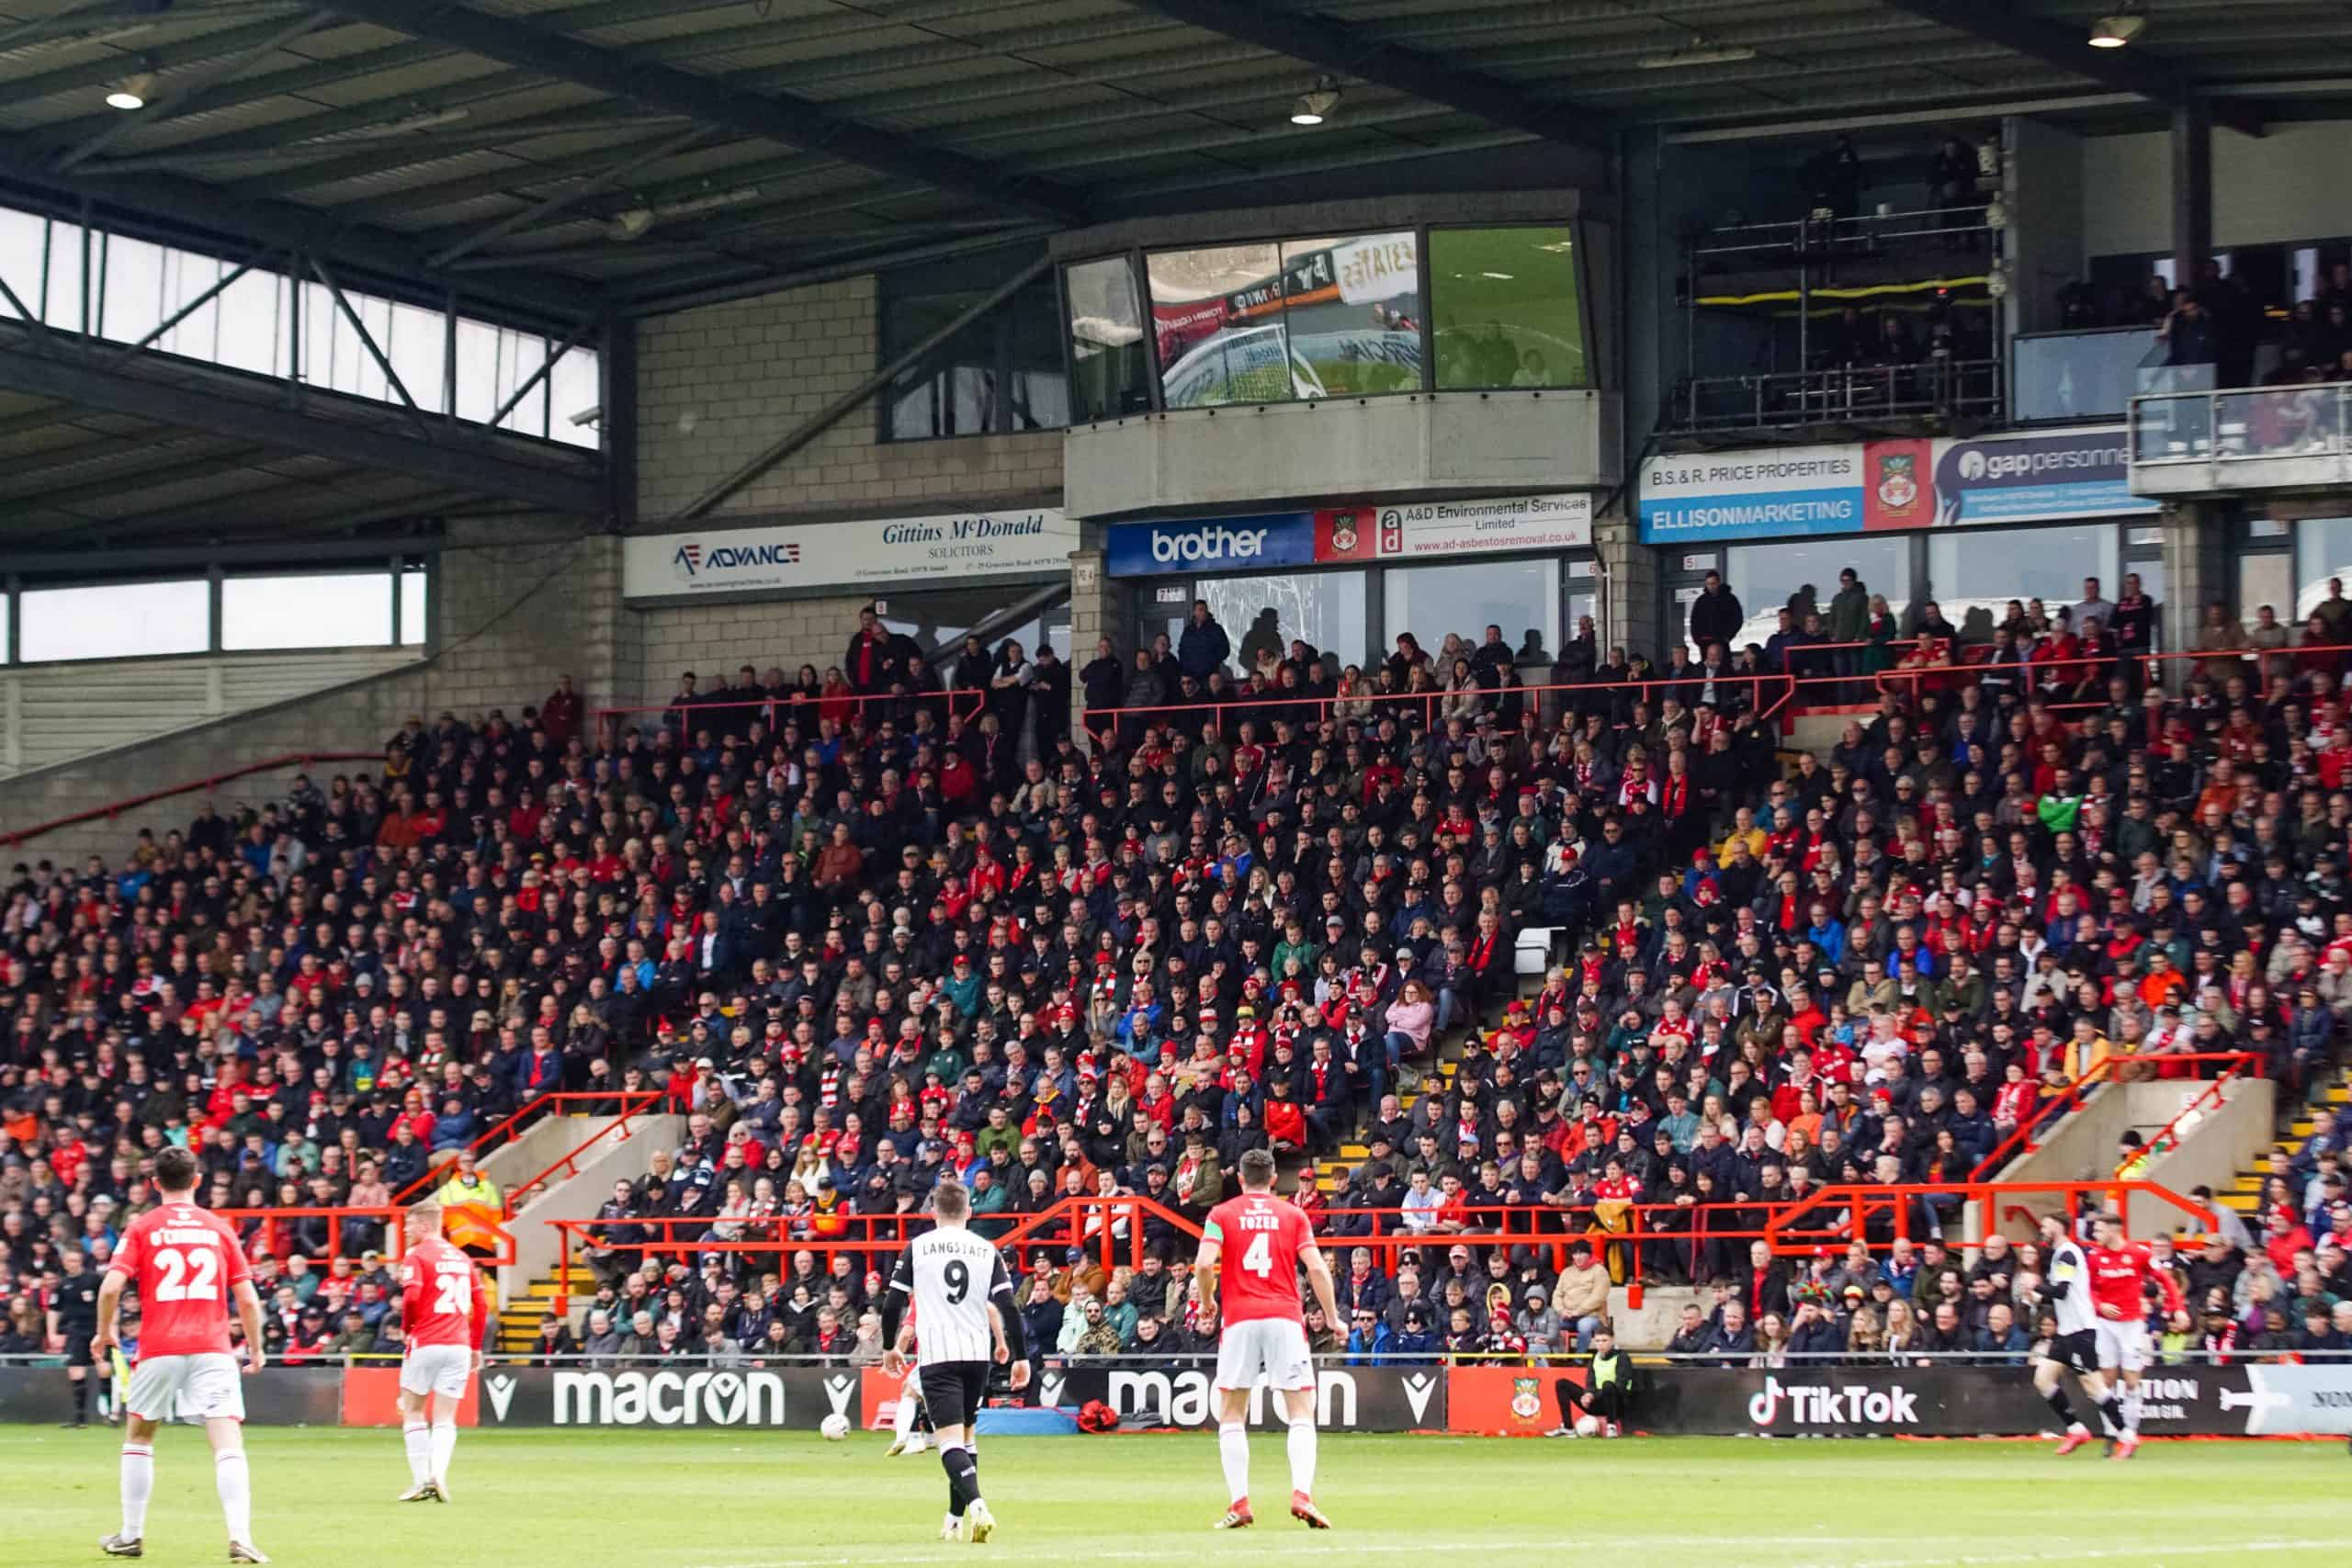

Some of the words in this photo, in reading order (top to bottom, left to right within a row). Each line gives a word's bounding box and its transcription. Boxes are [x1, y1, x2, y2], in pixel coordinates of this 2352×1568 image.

[1679, 469, 1690, 484] &
[1710, 465, 1754, 481] PRICE
[1758, 458, 1852, 479] PROPERTIES
[1987, 447, 2131, 479] gappersonne
[1406, 507, 1434, 522] A&D
[1437, 500, 1529, 520] Environmental
[1531, 499, 1587, 513] Services
[1476, 517, 1516, 531] Limited
[883, 523, 944, 545] Gittins
[949, 514, 1044, 540] McDonald
[1152, 525, 1268, 563] brother
[1415, 531, 1577, 552] www.ad-asbestosremoval.co.uk
[705, 544, 800, 569] ADVANCE
[928, 544, 994, 559] SOLICITORS
[1238, 1215, 1280, 1230] TOZER
[1242, 1232, 1273, 1279] 4
[153, 1247, 219, 1303] 22
[944, 1258, 969, 1305] 9
[433, 1274, 472, 1315] 20
[553, 1371, 786, 1426] macron
[1108, 1370, 1357, 1427] marn
[1786, 1385, 1919, 1424] TikTok
